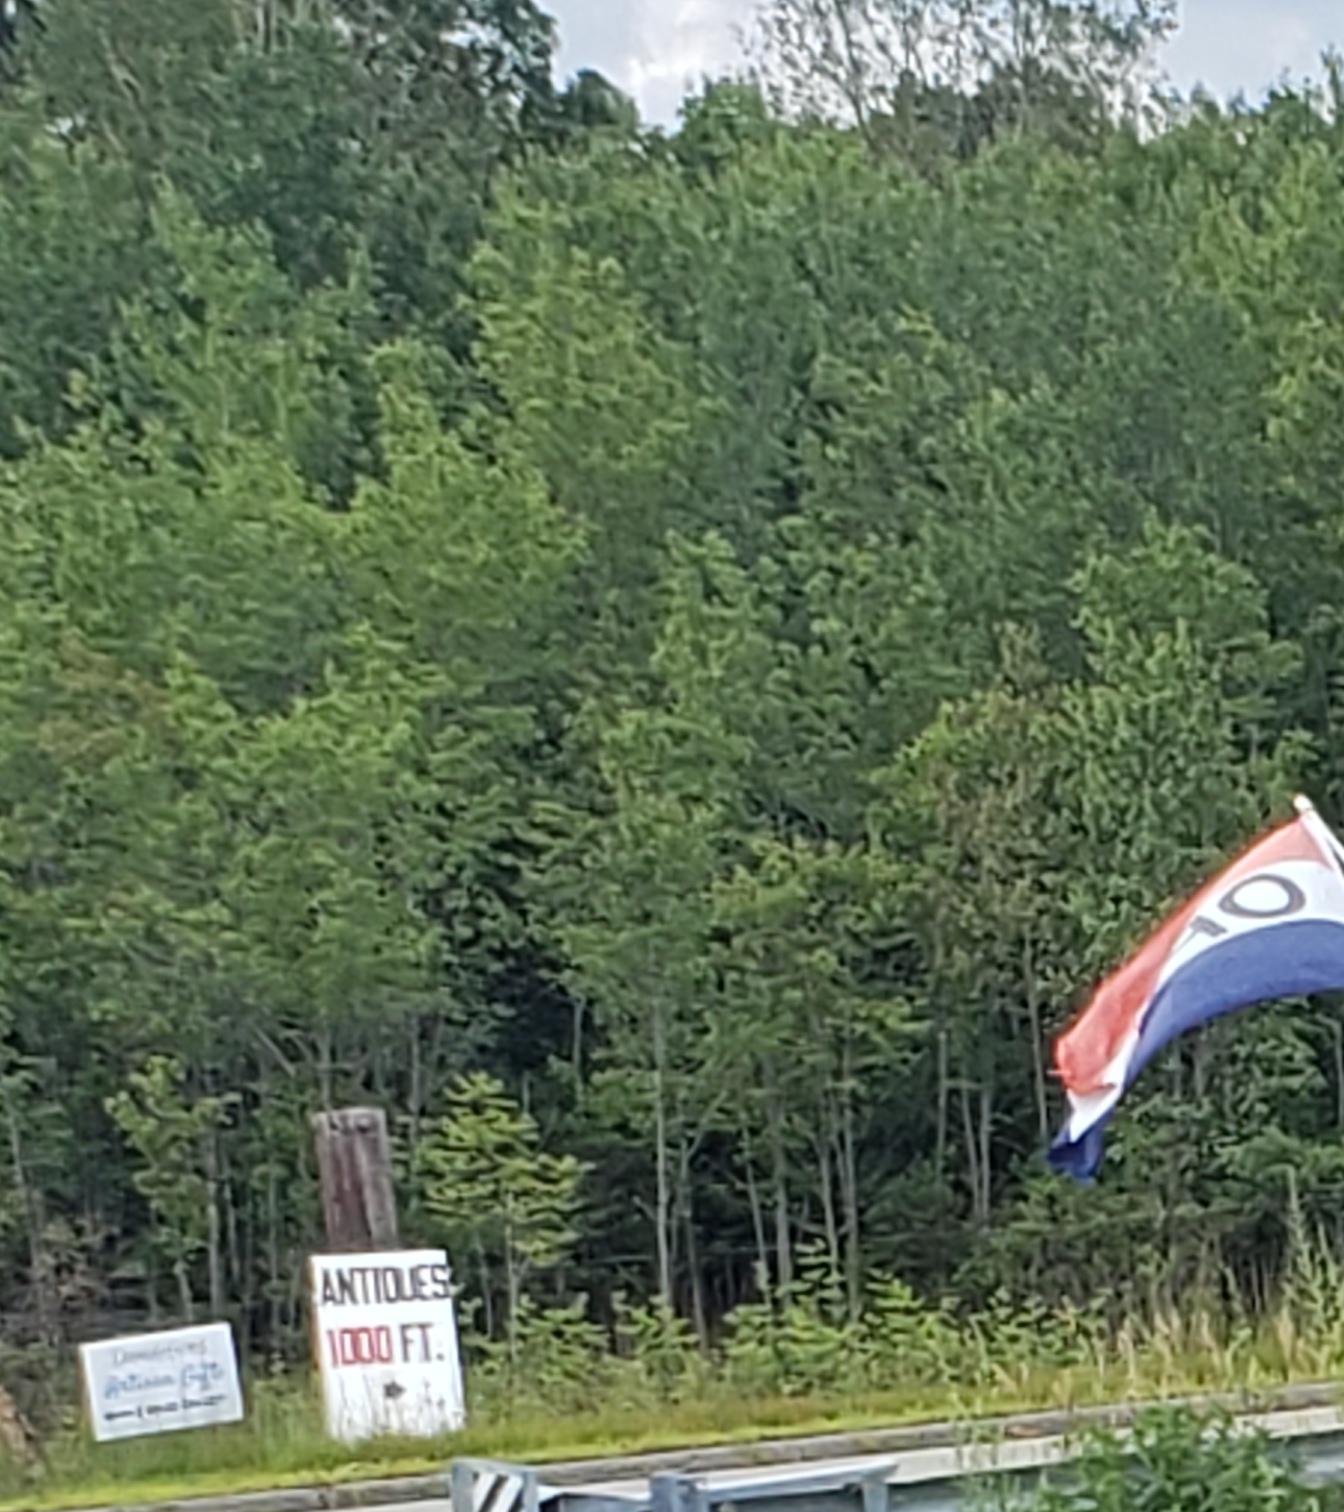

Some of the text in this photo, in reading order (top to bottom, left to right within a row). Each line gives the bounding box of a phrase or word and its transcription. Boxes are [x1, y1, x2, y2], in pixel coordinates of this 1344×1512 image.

[321, 1264, 451, 1306] ANTIQUES
[326, 1321, 445, 1369] 1000 FT.
